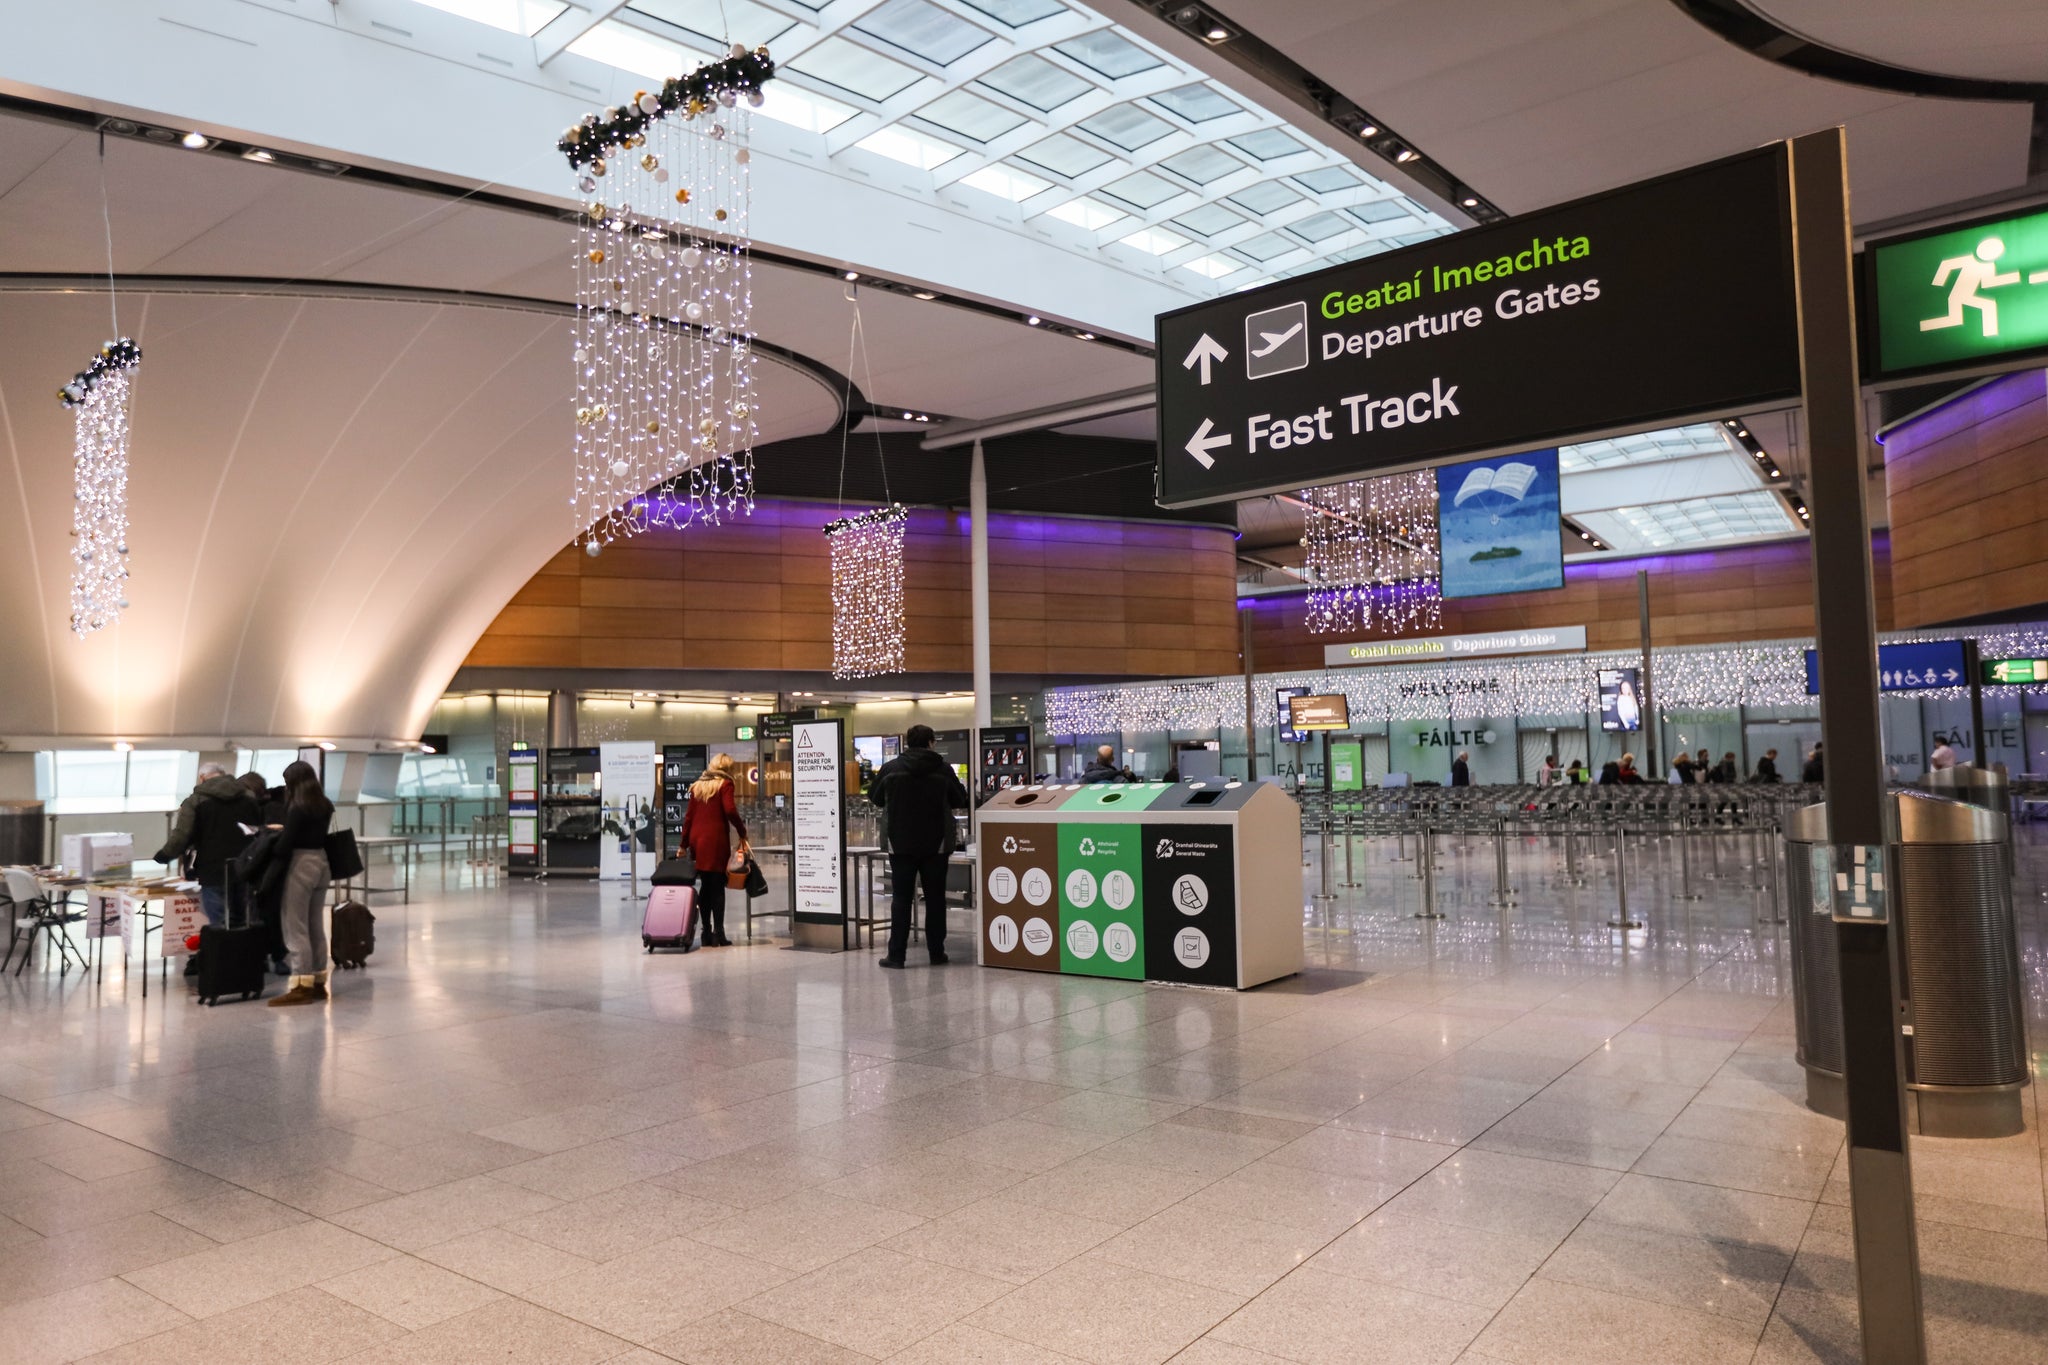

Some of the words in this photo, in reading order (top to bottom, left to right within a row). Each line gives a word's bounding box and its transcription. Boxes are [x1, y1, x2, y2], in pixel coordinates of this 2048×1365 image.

[1321, 270, 1422, 319] Geataí
[1433, 236, 1591, 293] Imeachta
[1322, 307, 1483, 361] Departure
[1495, 278, 1601, 320] Gates
[1247, 406, 1333, 454] Fast
[1341, 377, 1460, 435] Track
[1390, 641, 1444, 656] Imeachta
[1452, 636, 1516, 653] Departure
[1519, 633, 1557, 647] Gates
[1400, 678, 1501, 698] WELCOME
[1418, 728, 1486, 747] FÁILTE
[1932, 726, 2018, 749] FÁITE
[1277, 760, 1324, 779] FÁLTE
[174, 898, 200, 906] BOOK
